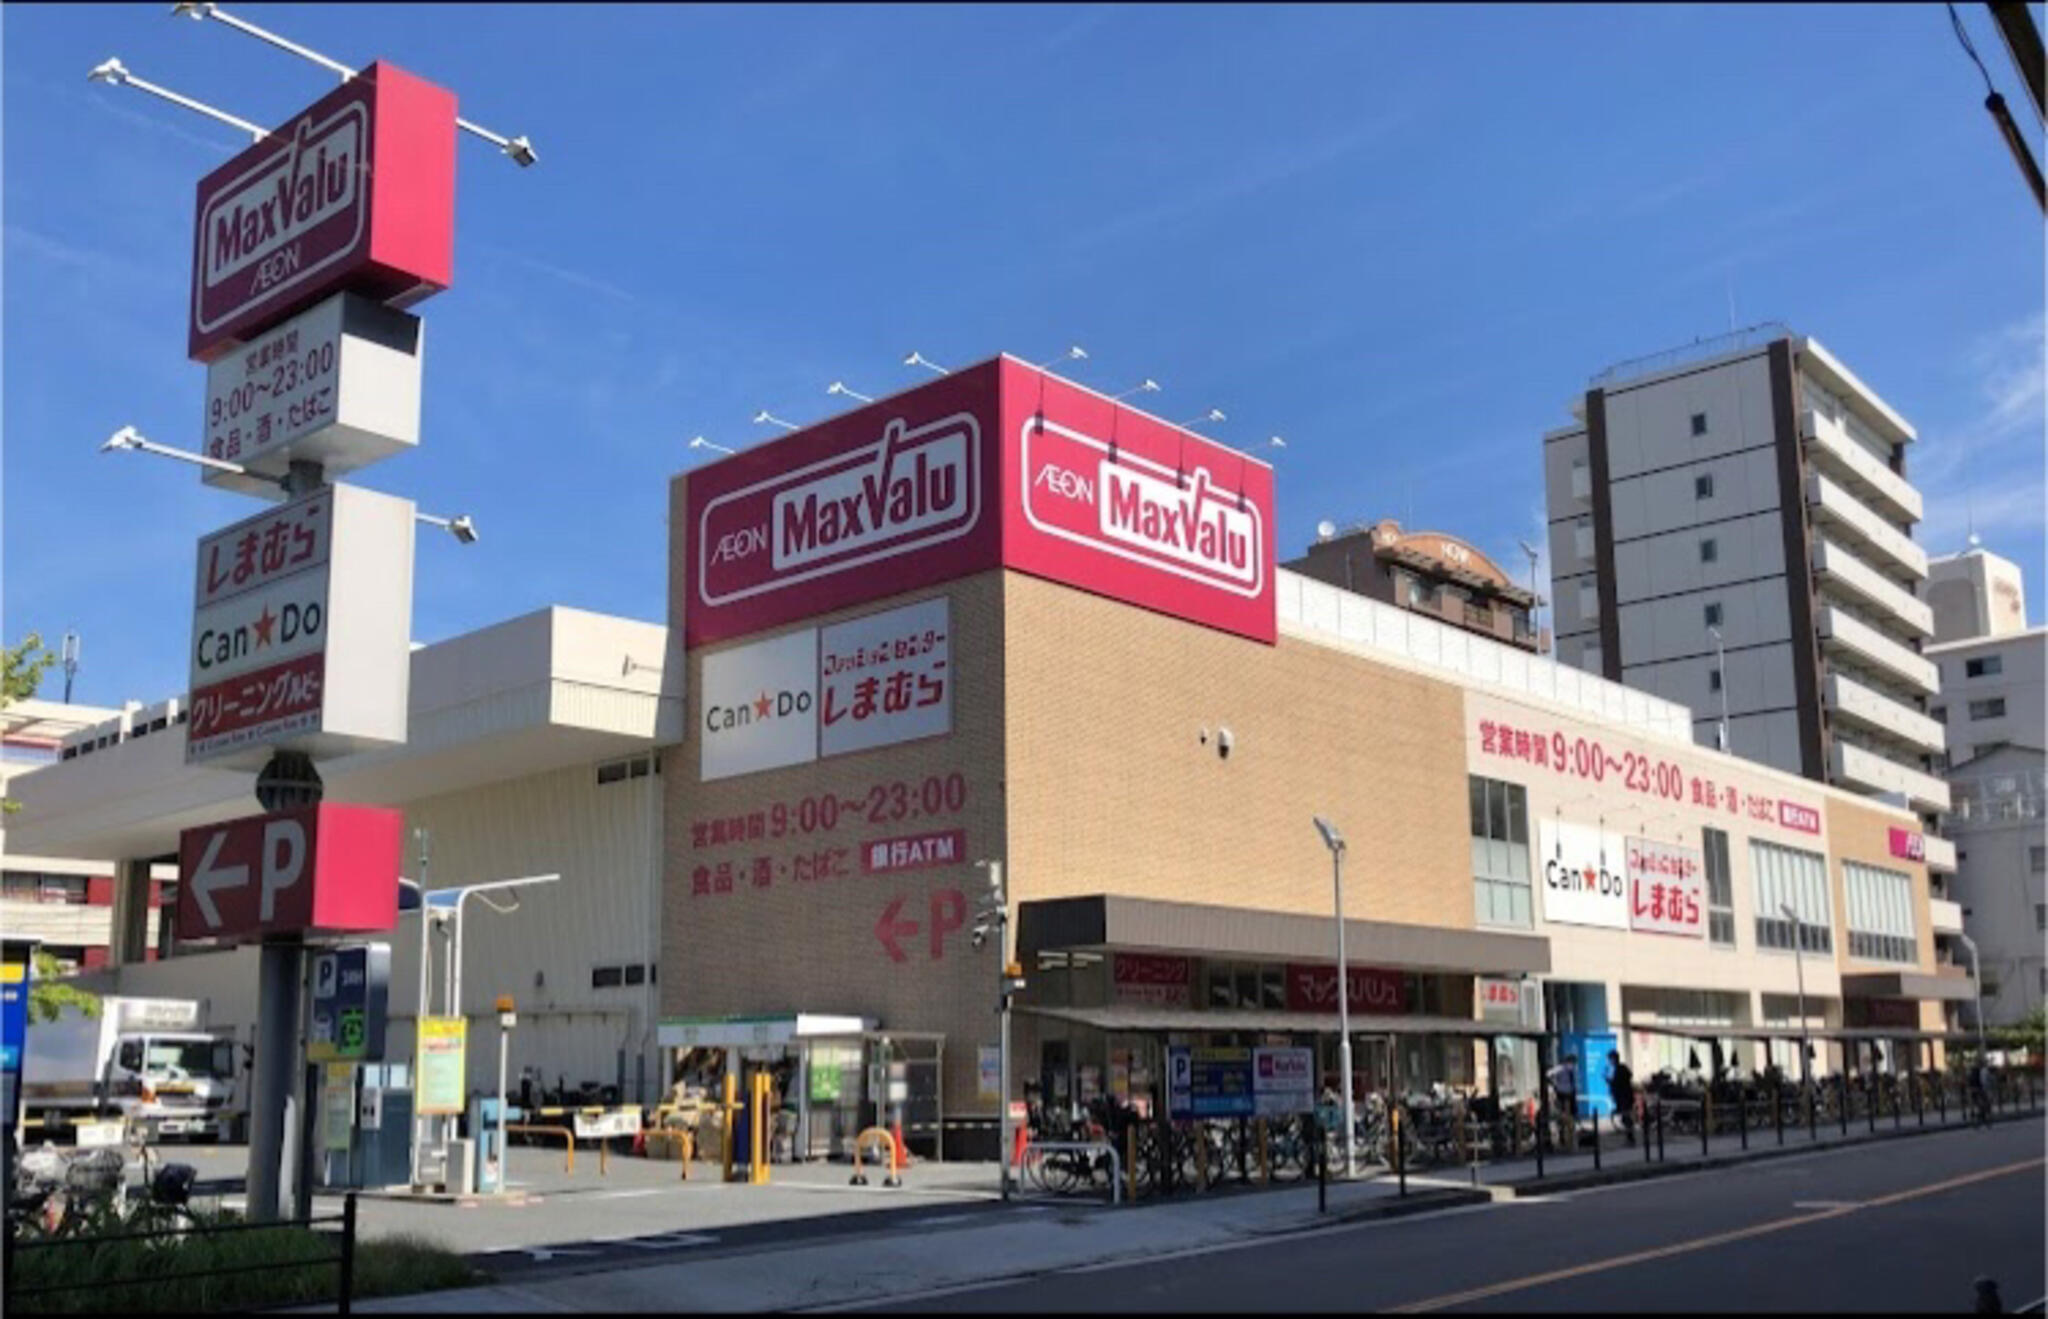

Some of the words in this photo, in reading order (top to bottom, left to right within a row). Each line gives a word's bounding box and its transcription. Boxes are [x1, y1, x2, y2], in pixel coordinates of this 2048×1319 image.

[213, 130, 350, 272] MaxValu
[246, 329, 298, 376] 営業時間
[782, 437, 957, 559] MaxValu
[1108, 471, 1247, 571] MaxValu
[206, 507, 320, 593] しまむら
[198, 625, 247, 669] Can
[280, 600, 322, 645] Do
[707, 701, 750, 733] Can
[777, 690, 812, 717] Do
[824, 660, 946, 727] しまむら
[1479, 718, 1548, 767] 営業時間
[692, 811, 766, 849] 営業時間
[259, 818, 307, 922] P
[1545, 858, 1582, 891] Can
[1599, 865, 1623, 897] Do
[928, 888, 967, 960] P
[1634, 879, 1699, 924] しまむら
[319, 960, 332, 988] P
[1176, 1056, 1186, 1080] P
